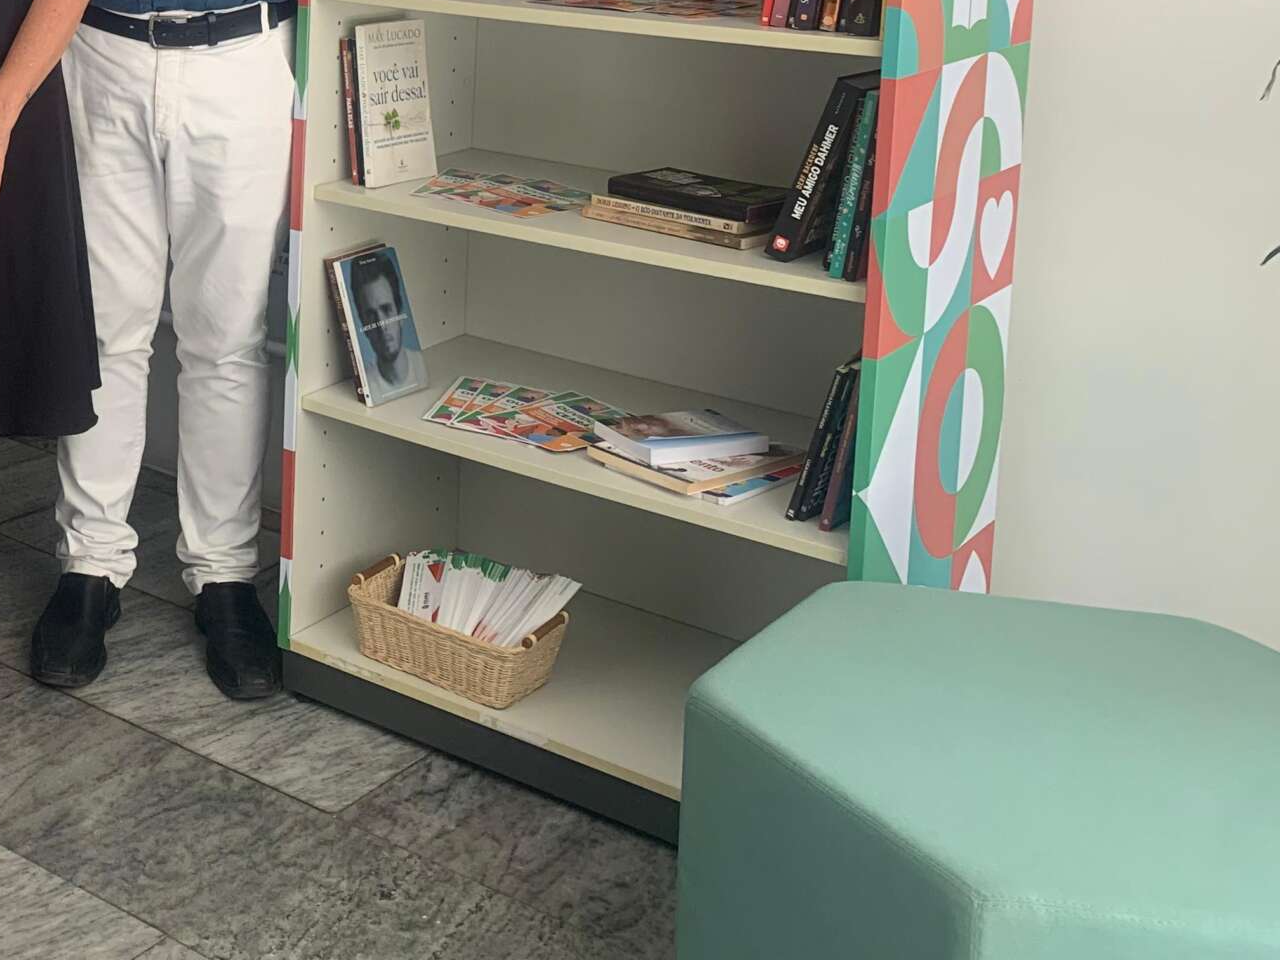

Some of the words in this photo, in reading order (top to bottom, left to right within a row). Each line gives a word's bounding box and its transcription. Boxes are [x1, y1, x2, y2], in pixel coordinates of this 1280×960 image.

[386, 28, 421, 42] LUCADO
[373, 63, 400, 83] você
[401, 60, 420, 80] vai
[370, 86, 390, 107] sair
[391, 81, 427, 104] dessa!
[790, 198, 807, 221] MEU
[803, 166, 821, 200] AMIGO
[815, 123, 840, 165] DAHMER
